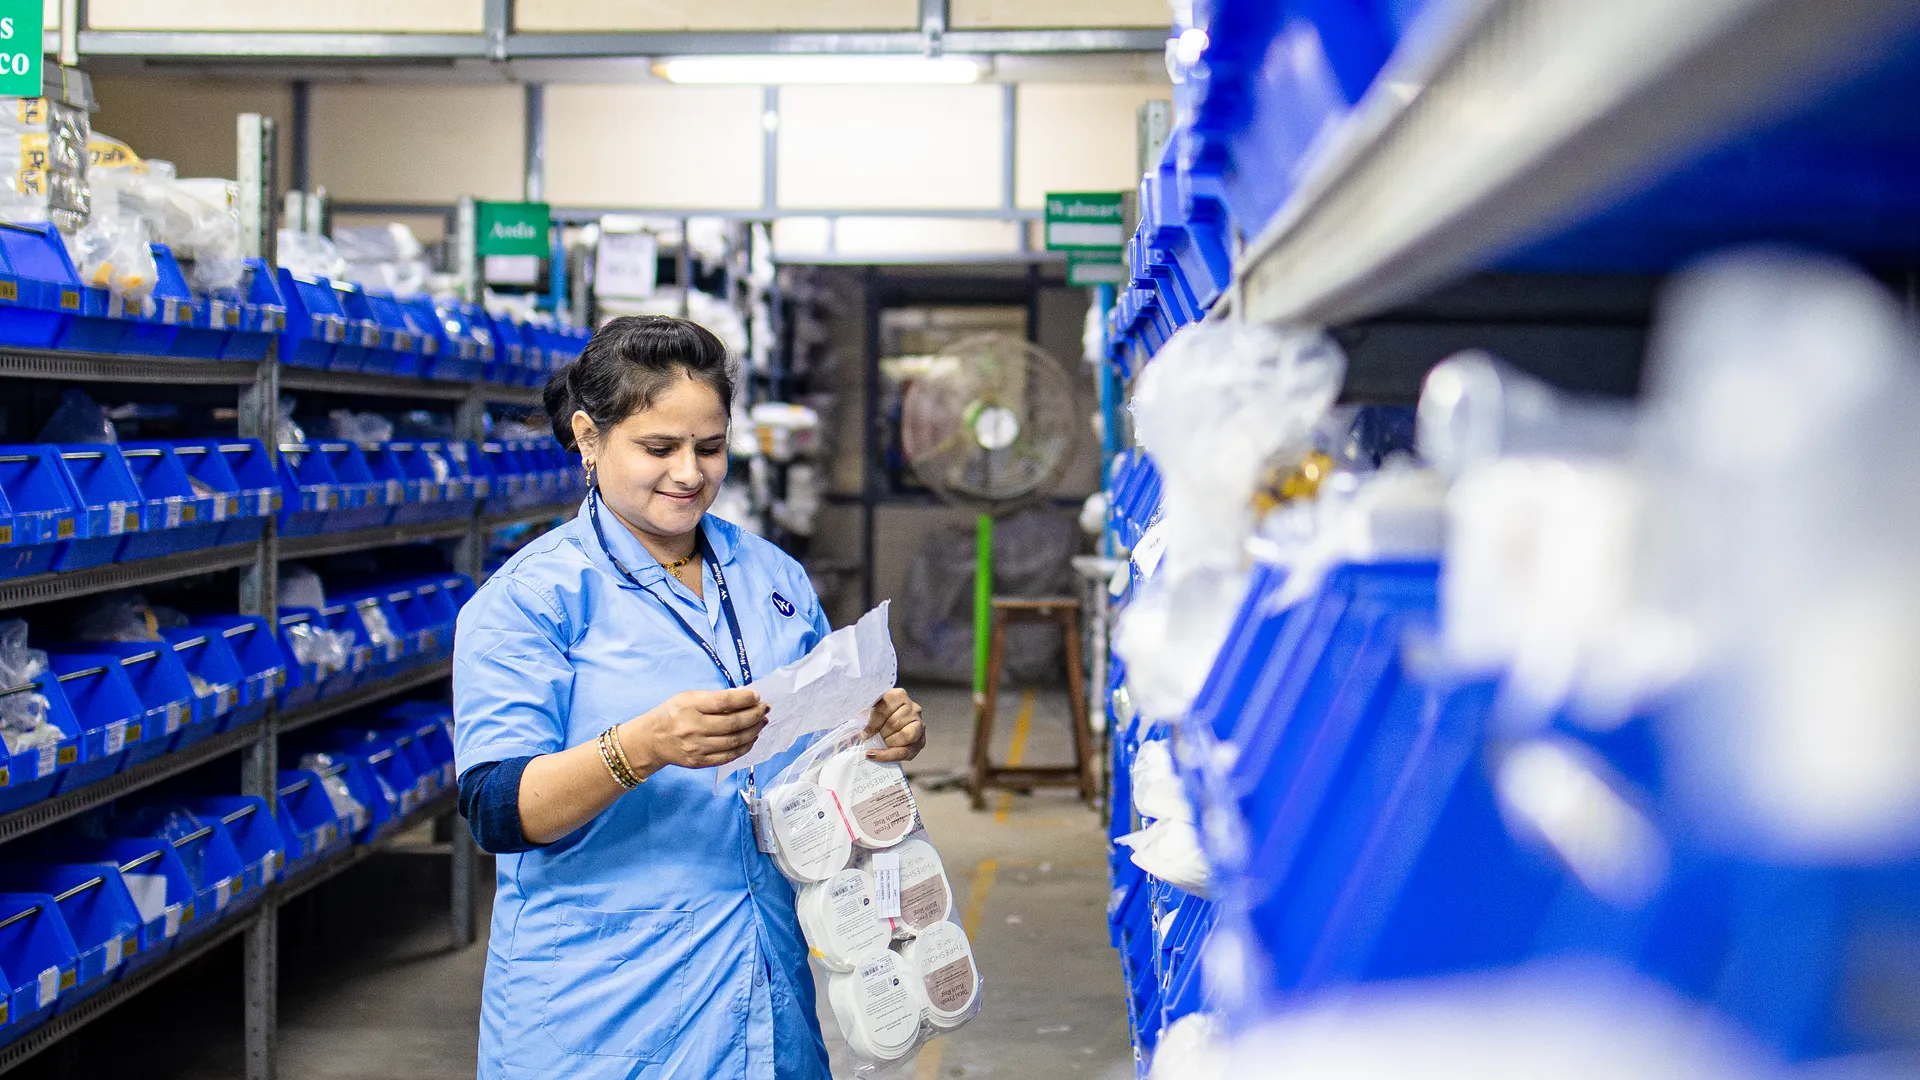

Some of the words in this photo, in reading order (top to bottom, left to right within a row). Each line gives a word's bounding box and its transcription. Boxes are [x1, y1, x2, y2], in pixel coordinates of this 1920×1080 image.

[848, 771, 894, 799] THRESHOLD
[901, 861, 935, 882] THRESHO
[920, 943, 963, 968] THRESHOLD
